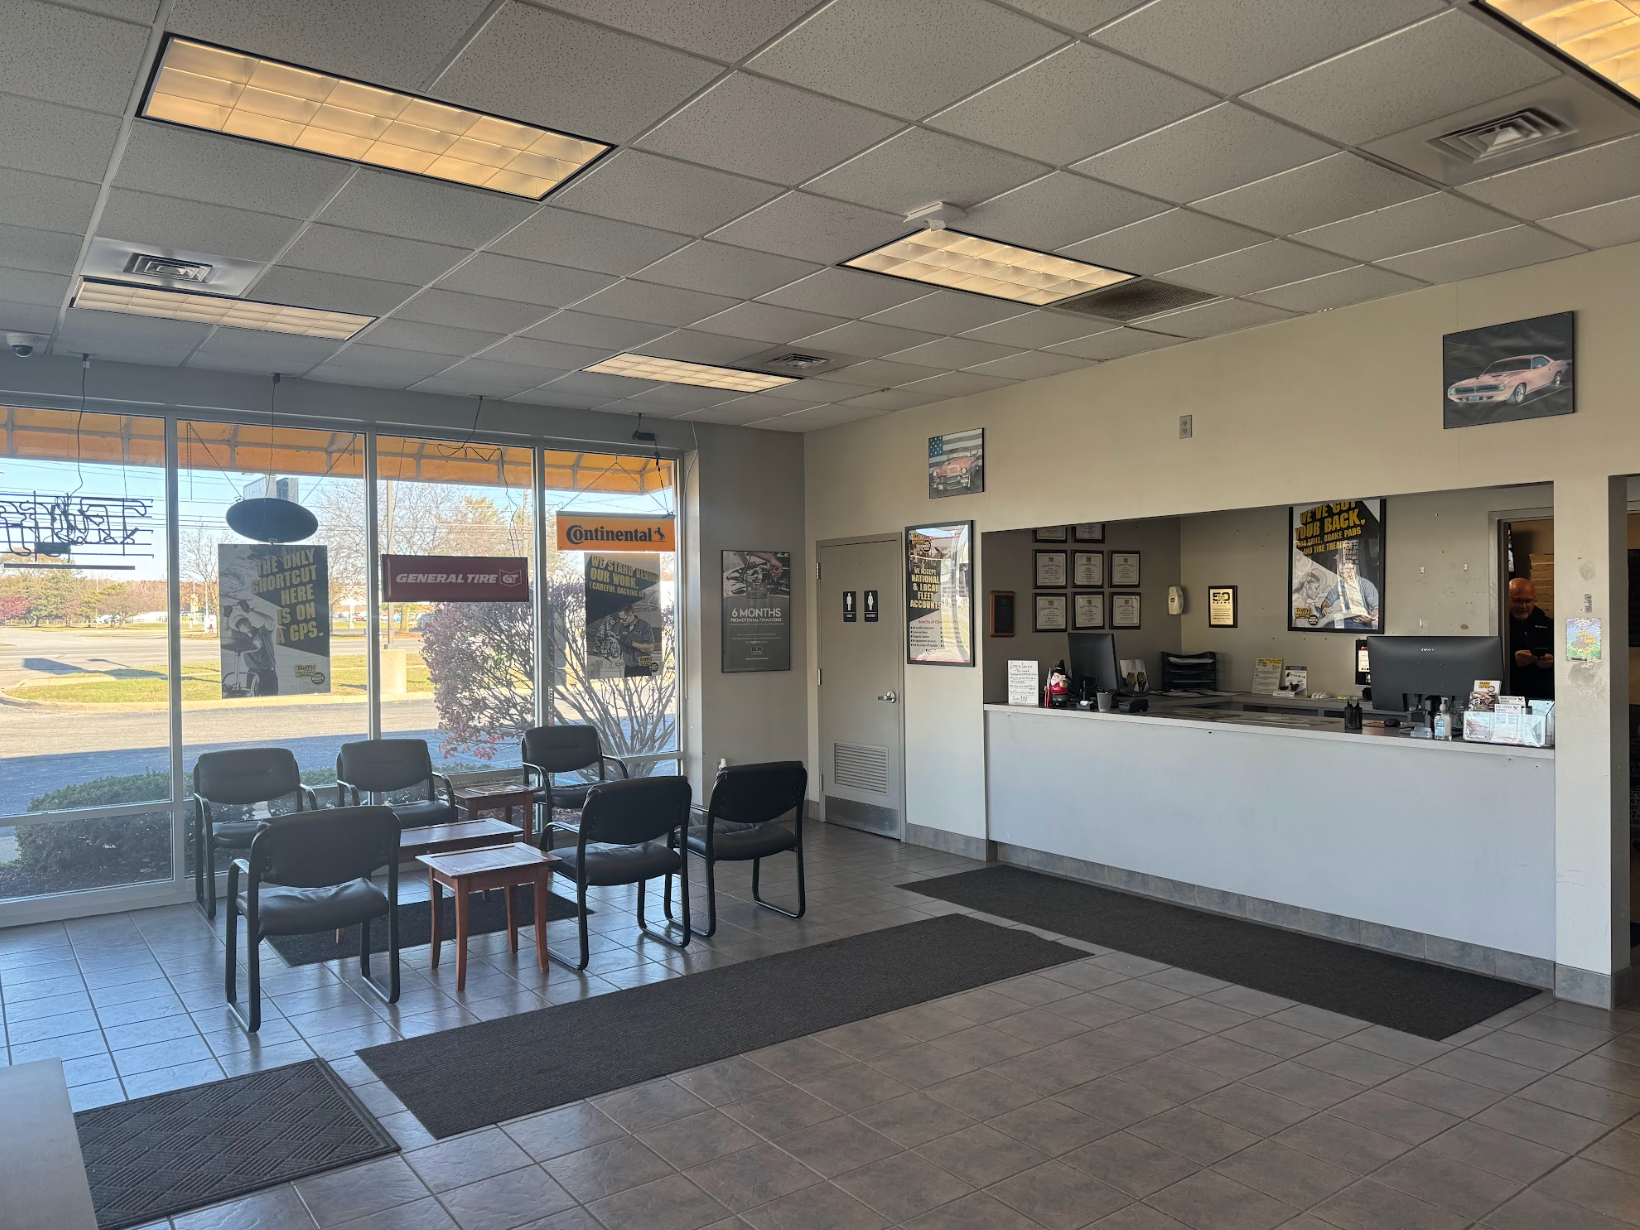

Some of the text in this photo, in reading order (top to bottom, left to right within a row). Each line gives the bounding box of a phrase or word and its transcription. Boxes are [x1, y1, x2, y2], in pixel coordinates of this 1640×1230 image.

[1300, 503, 1328, 524] WE'VE
[1295, 508, 1366, 540] YOUR BACK,
[566, 525, 652, 545] Continental
[1324, 531, 1342, 542] BRAKE
[1344, 527, 1361, 537] PADS
[257, 548, 315, 577] THE ONLY
[591, 554, 605, 569] WE
[607, 560, 634, 576] STAND
[251, 565, 317, 595] SHORTCUT
[395, 574, 464, 583] GENERAL
[466, 574, 498, 583] TIRE
[590, 568, 639, 589] OUR WORK.
[912, 574, 940, 583] NATIONAL
[913, 583, 939, 592] & LOCAL
[281, 584, 314, 605] HERE
[918, 591, 935, 600] FLEET
[1213, 592, 1230, 601] 50
[277, 602, 316, 625] IS ON
[731, 608, 781, 617] 6 MONTHS
[910, 600, 941, 610] ACCOUNTS
[276, 627, 285, 645] A
